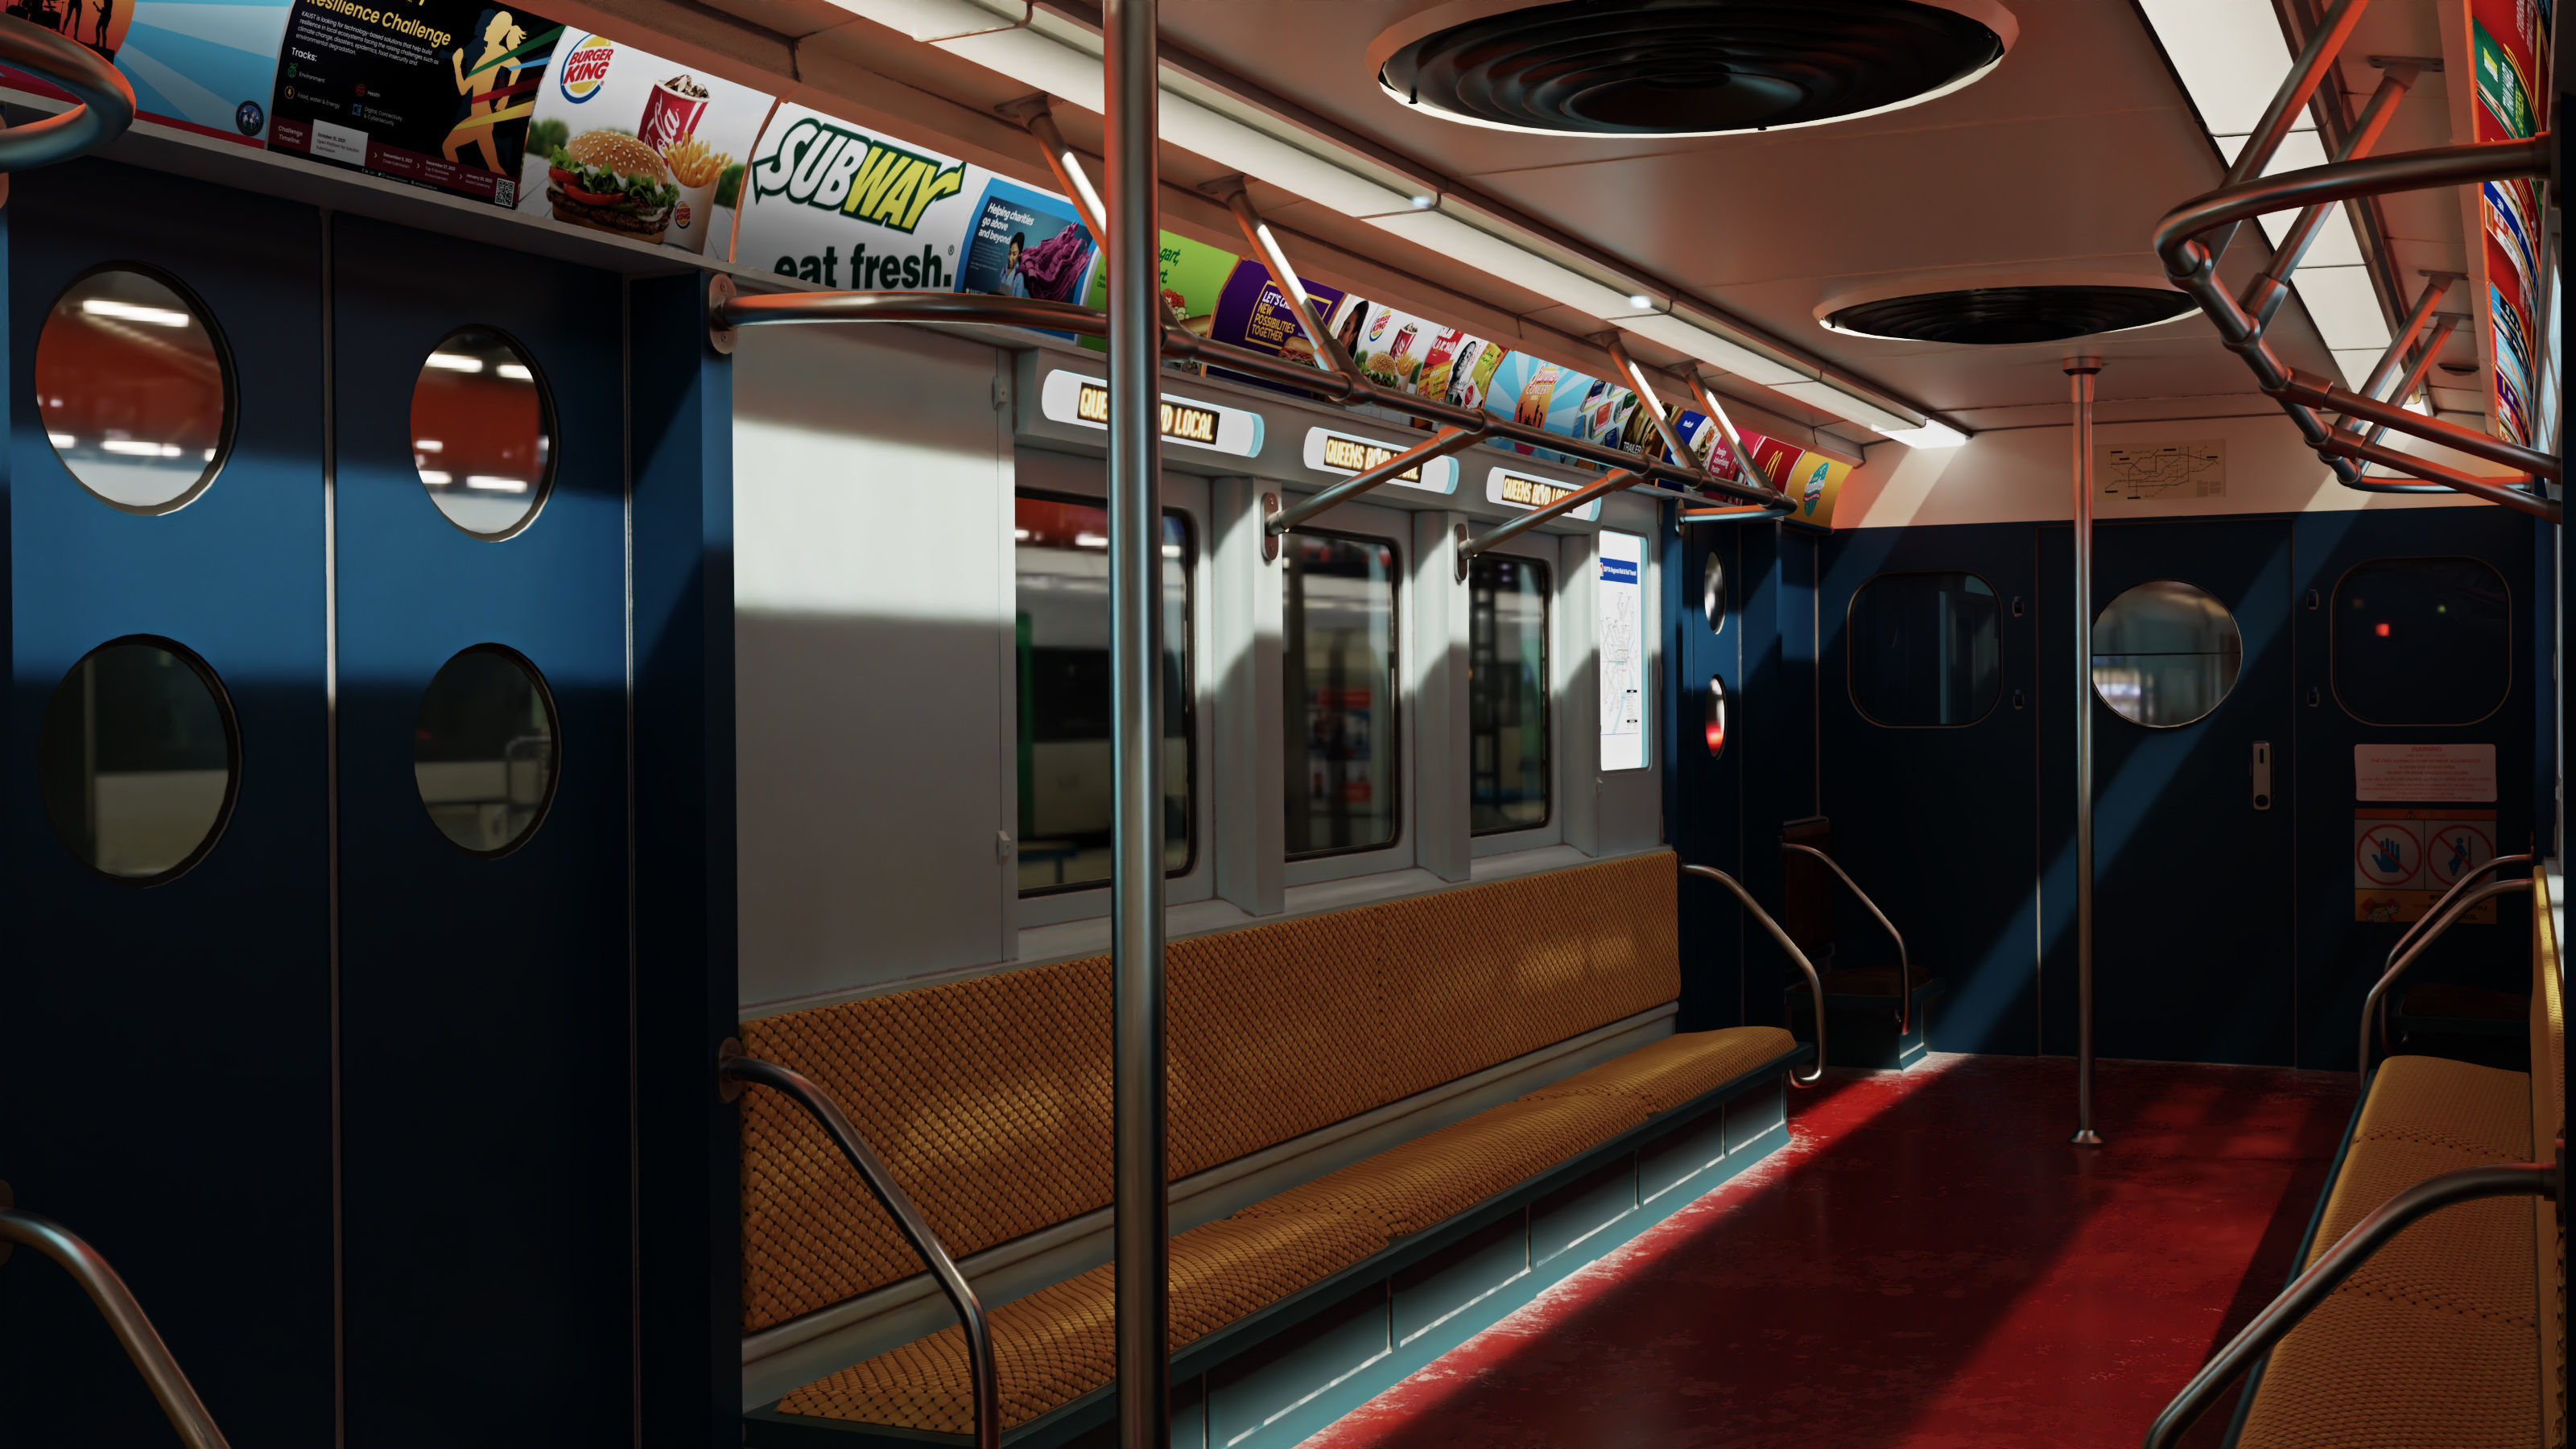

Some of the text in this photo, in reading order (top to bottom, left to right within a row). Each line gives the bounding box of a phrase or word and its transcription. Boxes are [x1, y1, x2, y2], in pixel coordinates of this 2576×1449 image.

[306, 0, 452, 48] esilience Challenge
[295, 33, 328, 47] environmental
[301, 10, 317, 20] KAUST
[320, 16, 336, 28] looking
[384, 36, 402, 47] solutions
[402, 41, 412, 49] that
[411, 44, 422, 53] help
[421, 47, 433, 56] build
[297, 26, 316, 35] climate
[378, 49, 389, 57] food
[388, 52, 409, 64] insecurity
[299, 19, 321, 30] resilience
[326, 26, 338, 34] local
[337, 31, 364, 42] ecosystems
[364, 37, 378, 48] facing
[400, 48, 423, 60] challenges
[423, 56, 433, 64] such
[291, 47, 318, 62] Tracks:
[568, 48, 614, 66] BURGER
[299, 71, 326, 84] Environment
[563, 61, 609, 85] KING
[367, 90, 381, 98] Health
[309, 96, 323, 104] water
[326, 101, 341, 110] Energy
[367, 114, 395, 127] Cybersecurity
[378, 109, 403, 123] Connectivity
[278, 125, 303, 138] Challenge
[279, 134, 302, 145] Timeline:
[755, 120, 966, 233] SUBWAY
[675, 212, 691, 222] KING
[987, 201, 1035, 226] Helping charities
[980, 217, 1009, 232] go above
[977, 228, 1012, 245] and beyond
[774, 246, 838, 288] eat
[850, 243, 952, 290] fresh.
[1262, 291, 1282, 306] LET'S
[1257, 302, 1275, 316] NEW
[1253, 312, 1295, 335] POSSIBILITIES
[1371, 321, 1389, 333] KING
[1252, 324, 1284, 343] TOGETHER.
[1525, 384, 1554, 394] CONCERT
[1080, 387, 1108, 421] QUE
[1174, 407, 1214, 441] LOCAL
[1325, 439, 1365, 469] QUEENS
[1624, 441, 1641, 455] TRAILER
[1715, 447, 1728, 459] Design
[1713, 456, 1731, 470] Advertising
[1503, 477, 1533, 503] QUEENS
[1531, 484, 1551, 506] BLVD
